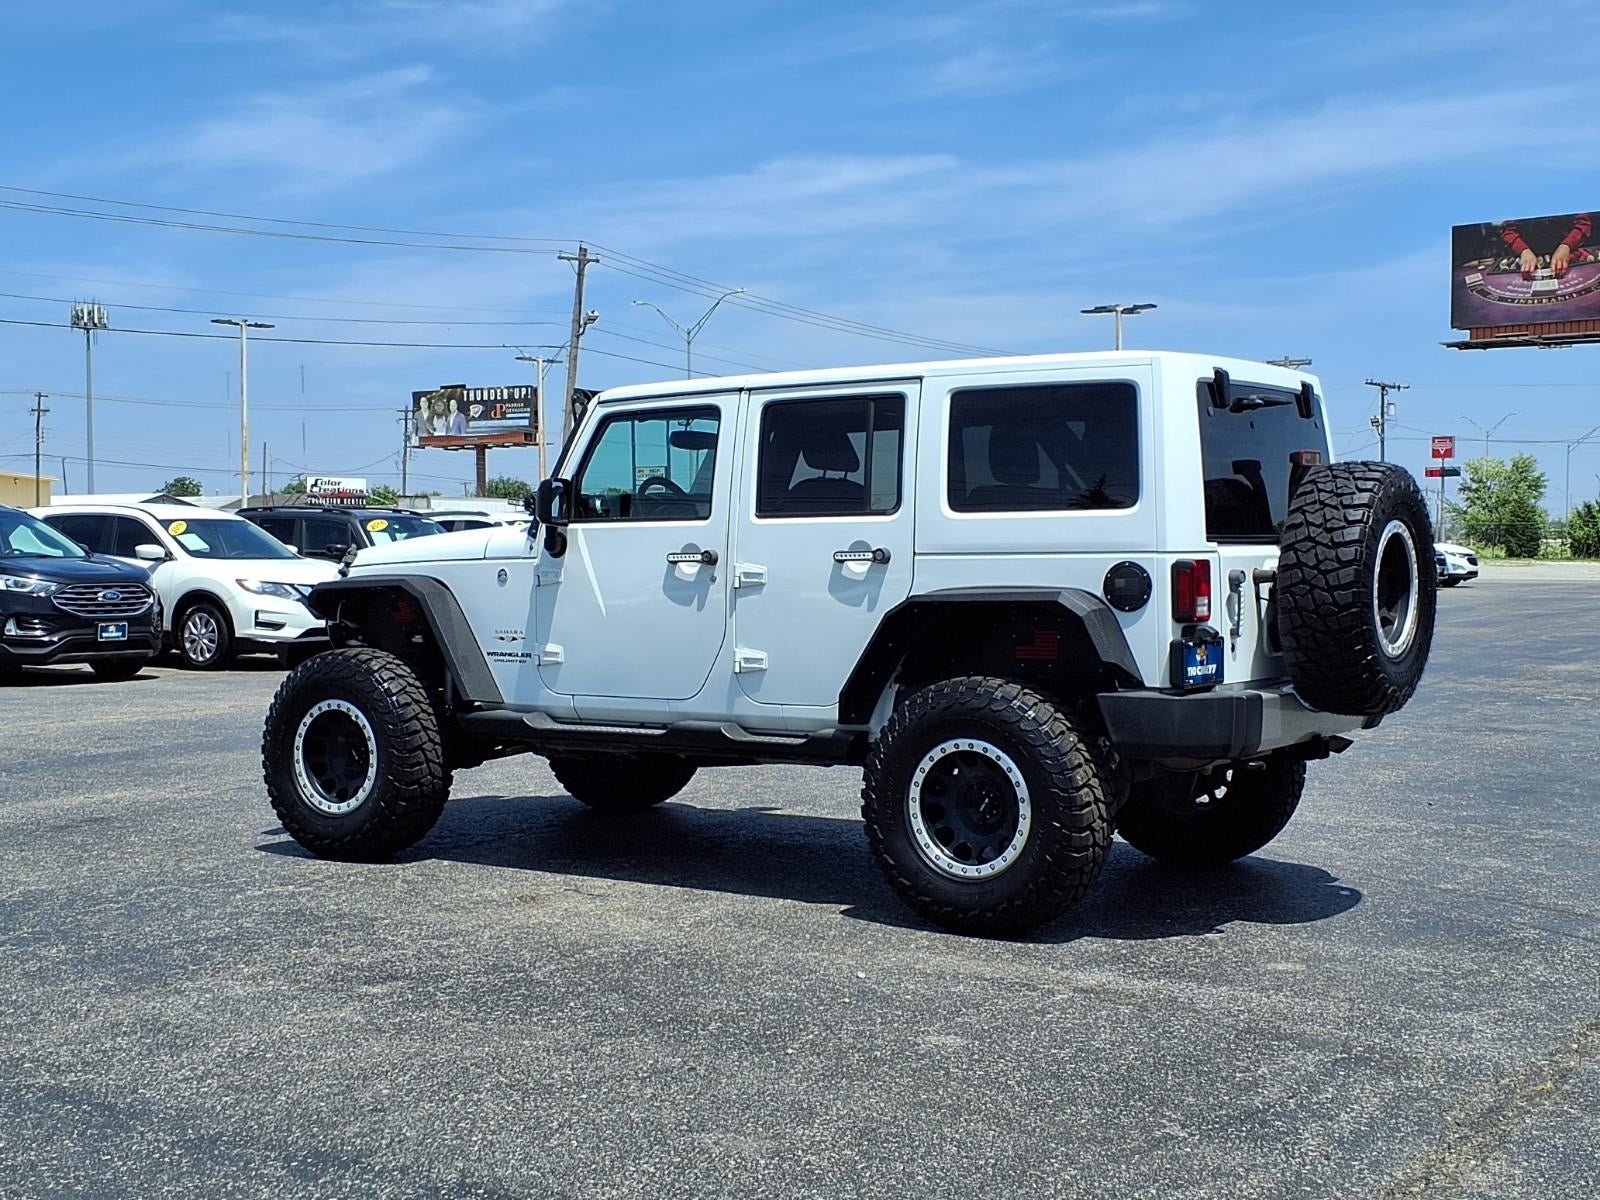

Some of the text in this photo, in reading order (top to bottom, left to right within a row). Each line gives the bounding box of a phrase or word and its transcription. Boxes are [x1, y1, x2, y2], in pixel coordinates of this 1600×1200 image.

[463, 387, 531, 402] THUNDER UP!
[313, 478, 342, 488] Color
[309, 485, 364, 494] Creations
[487, 651, 532, 659] WRANGLER
